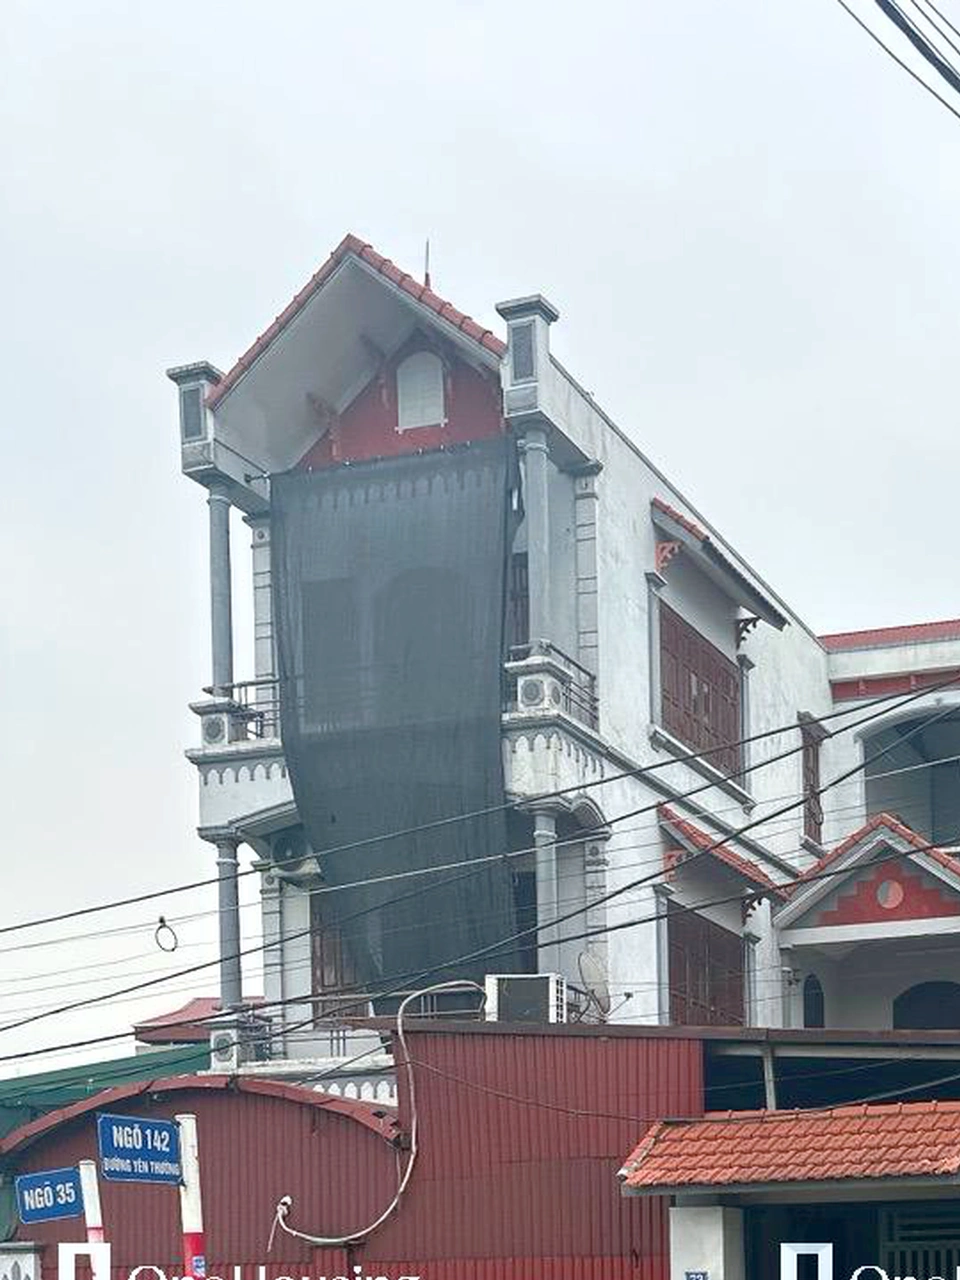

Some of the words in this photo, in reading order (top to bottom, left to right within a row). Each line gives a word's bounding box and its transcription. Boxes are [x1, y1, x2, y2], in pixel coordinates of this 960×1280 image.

[112, 1123, 143, 1149] NGÕ
[145, 1128, 170, 1152] 142
[23, 1181, 54, 1211] NGÕ
[56, 1182, 76, 1204] 35
